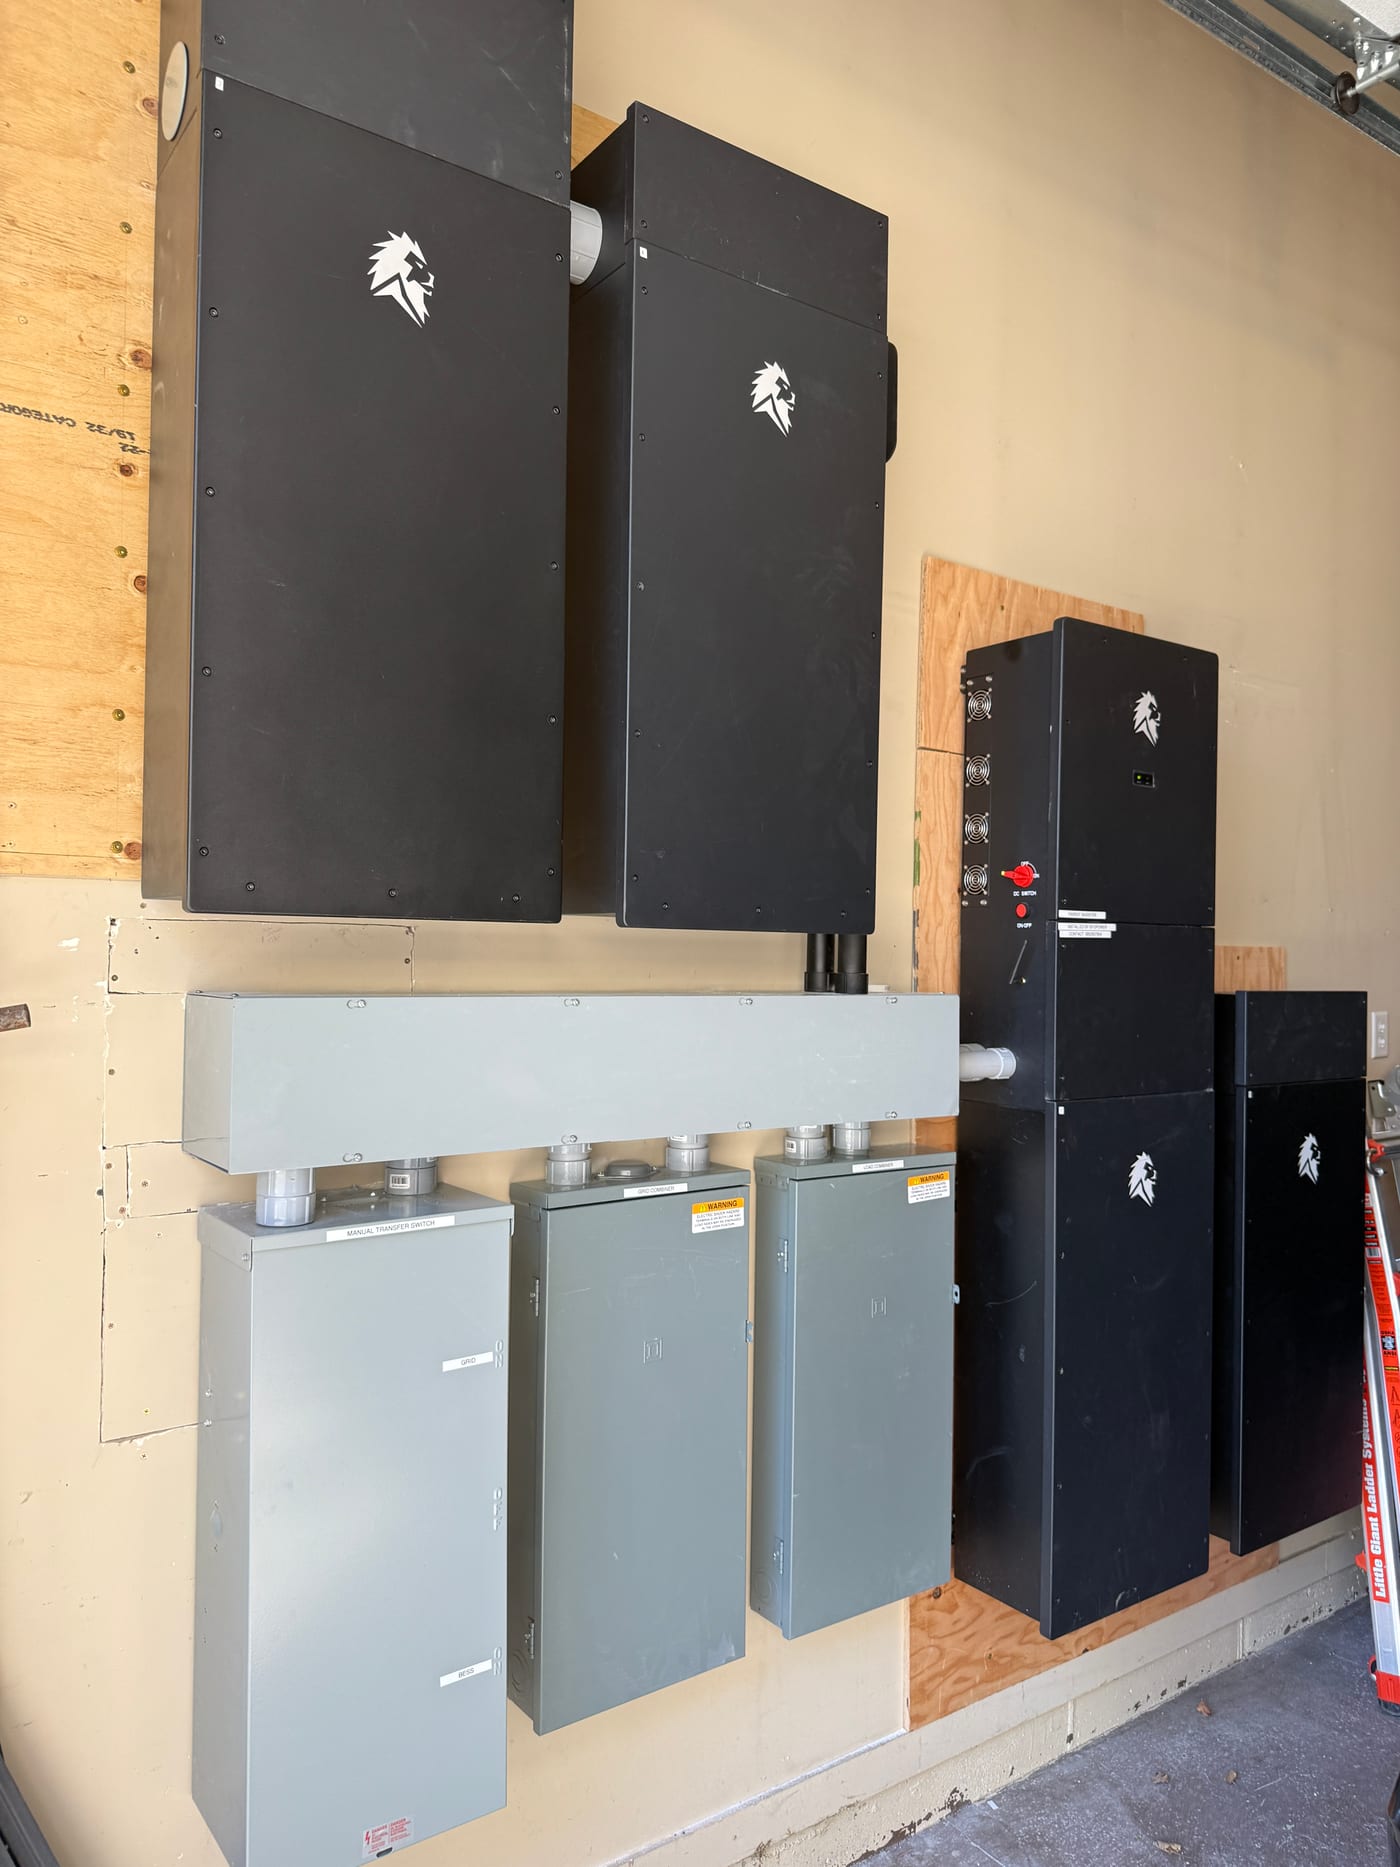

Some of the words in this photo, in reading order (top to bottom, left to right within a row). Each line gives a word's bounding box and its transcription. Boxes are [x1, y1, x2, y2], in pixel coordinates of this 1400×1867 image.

[920, 1174, 945, 1183] WARNING
[708, 1200, 738, 1211] WARNING
[347, 1228, 374, 1237] MANUAL
[376, 1222, 409, 1233] TRANSFER
[410, 1220, 435, 1228] SWITCH
[461, 1357, 476, 1365] GRID
[1364, 1463, 1378, 1513] Ladder
[1368, 1516, 1381, 1555] Giant
[1373, 1559, 1386, 1598] Little
